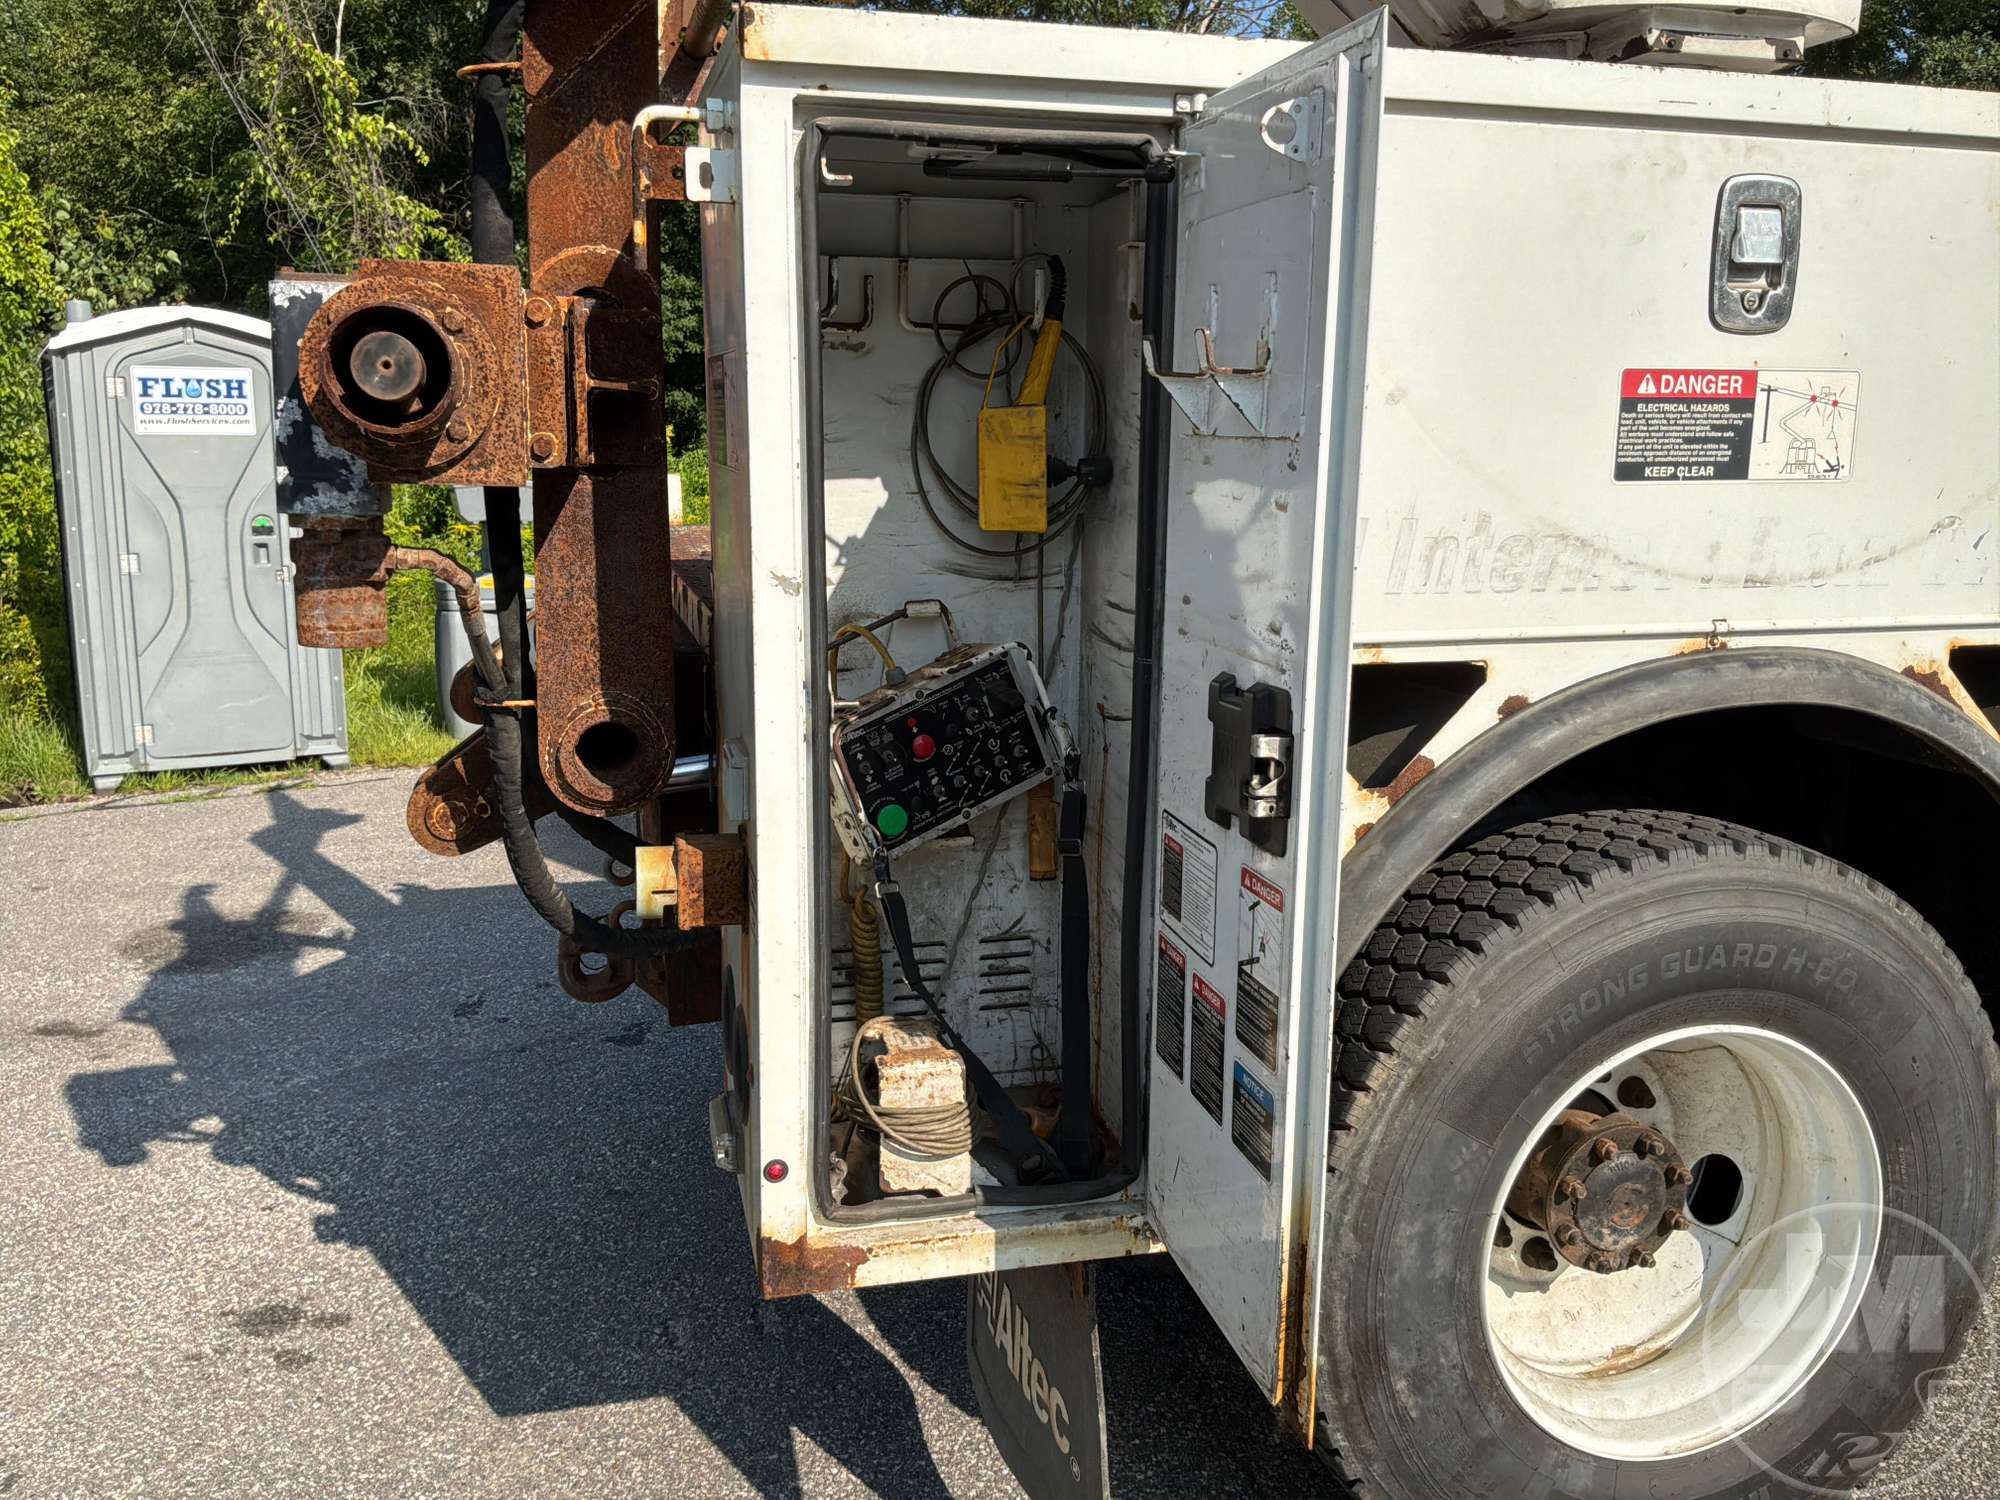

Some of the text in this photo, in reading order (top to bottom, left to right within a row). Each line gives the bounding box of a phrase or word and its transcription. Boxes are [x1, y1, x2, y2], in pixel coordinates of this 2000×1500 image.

[137, 377, 248, 399] FLUSH
[1660, 374, 1743, 394] DANGER
[142, 402, 245, 415] 978-778-8000
[1637, 403, 1730, 412] ELECTRICAL HAZARDS
[1644, 466, 1714, 477] KEEP CLEAR
[1251, 876, 1281, 906] DANGER
[1521, 962, 1649, 1064] STRONG
[1660, 943, 1777, 979] GUARD
[1242, 1073, 1265, 1101] NOTICE
[994, 1282, 1071, 1455] Altec
